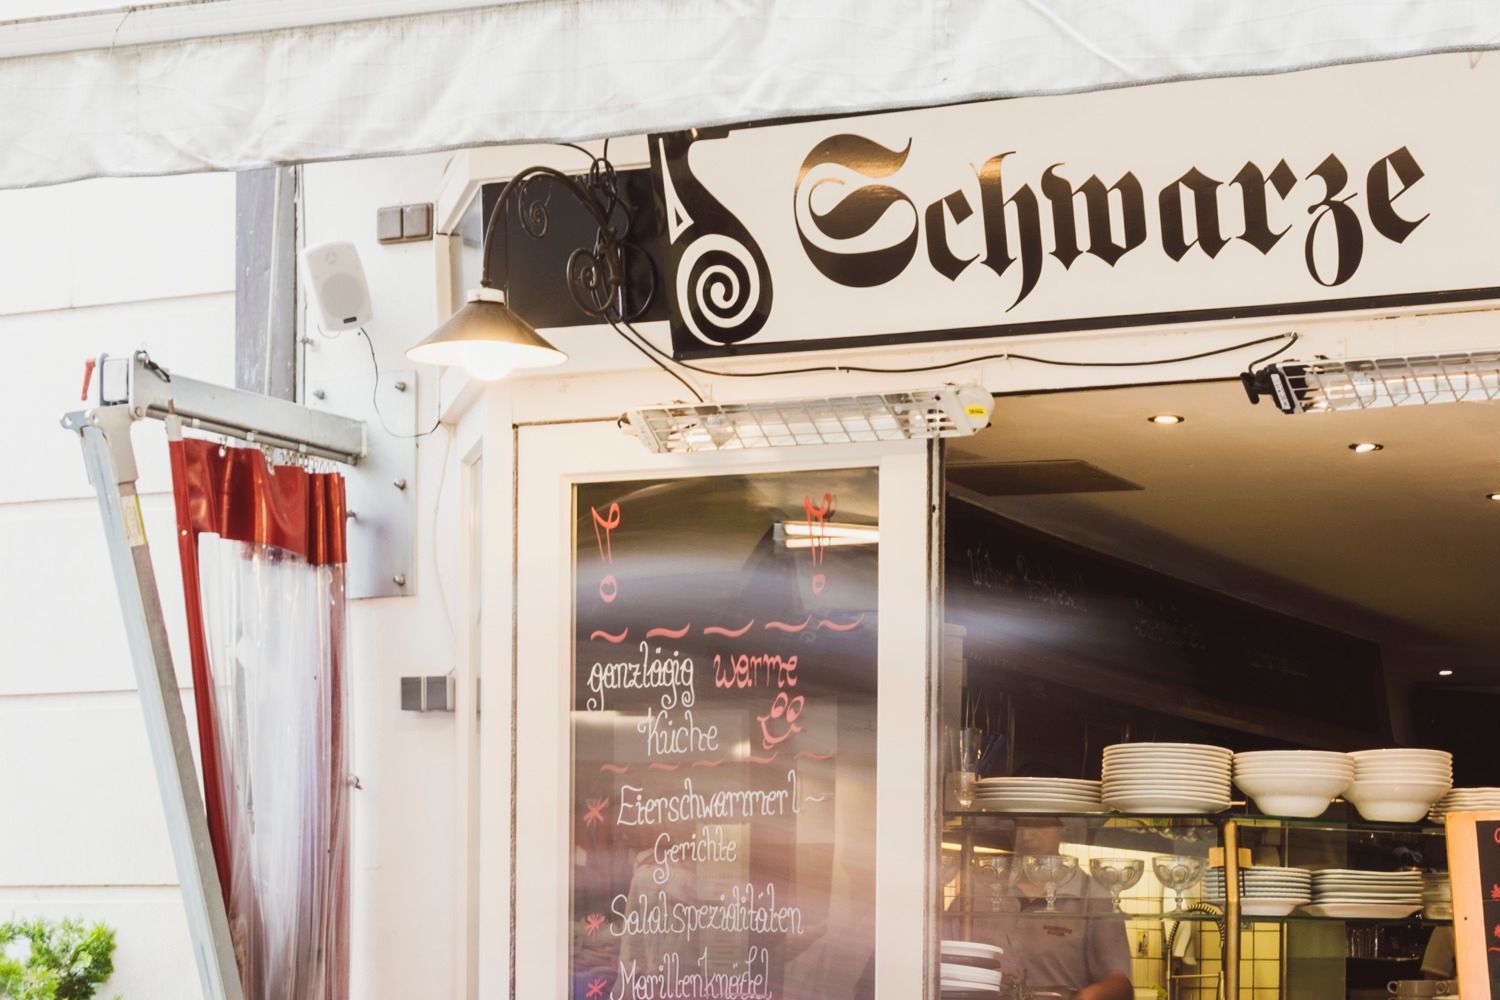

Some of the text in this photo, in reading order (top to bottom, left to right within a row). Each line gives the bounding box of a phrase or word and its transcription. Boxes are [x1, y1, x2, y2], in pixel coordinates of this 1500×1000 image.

[793, 133, 1431, 312] Schwarze
[713, 653, 798, 688] warme
[653, 826, 737, 884] Gerichte
